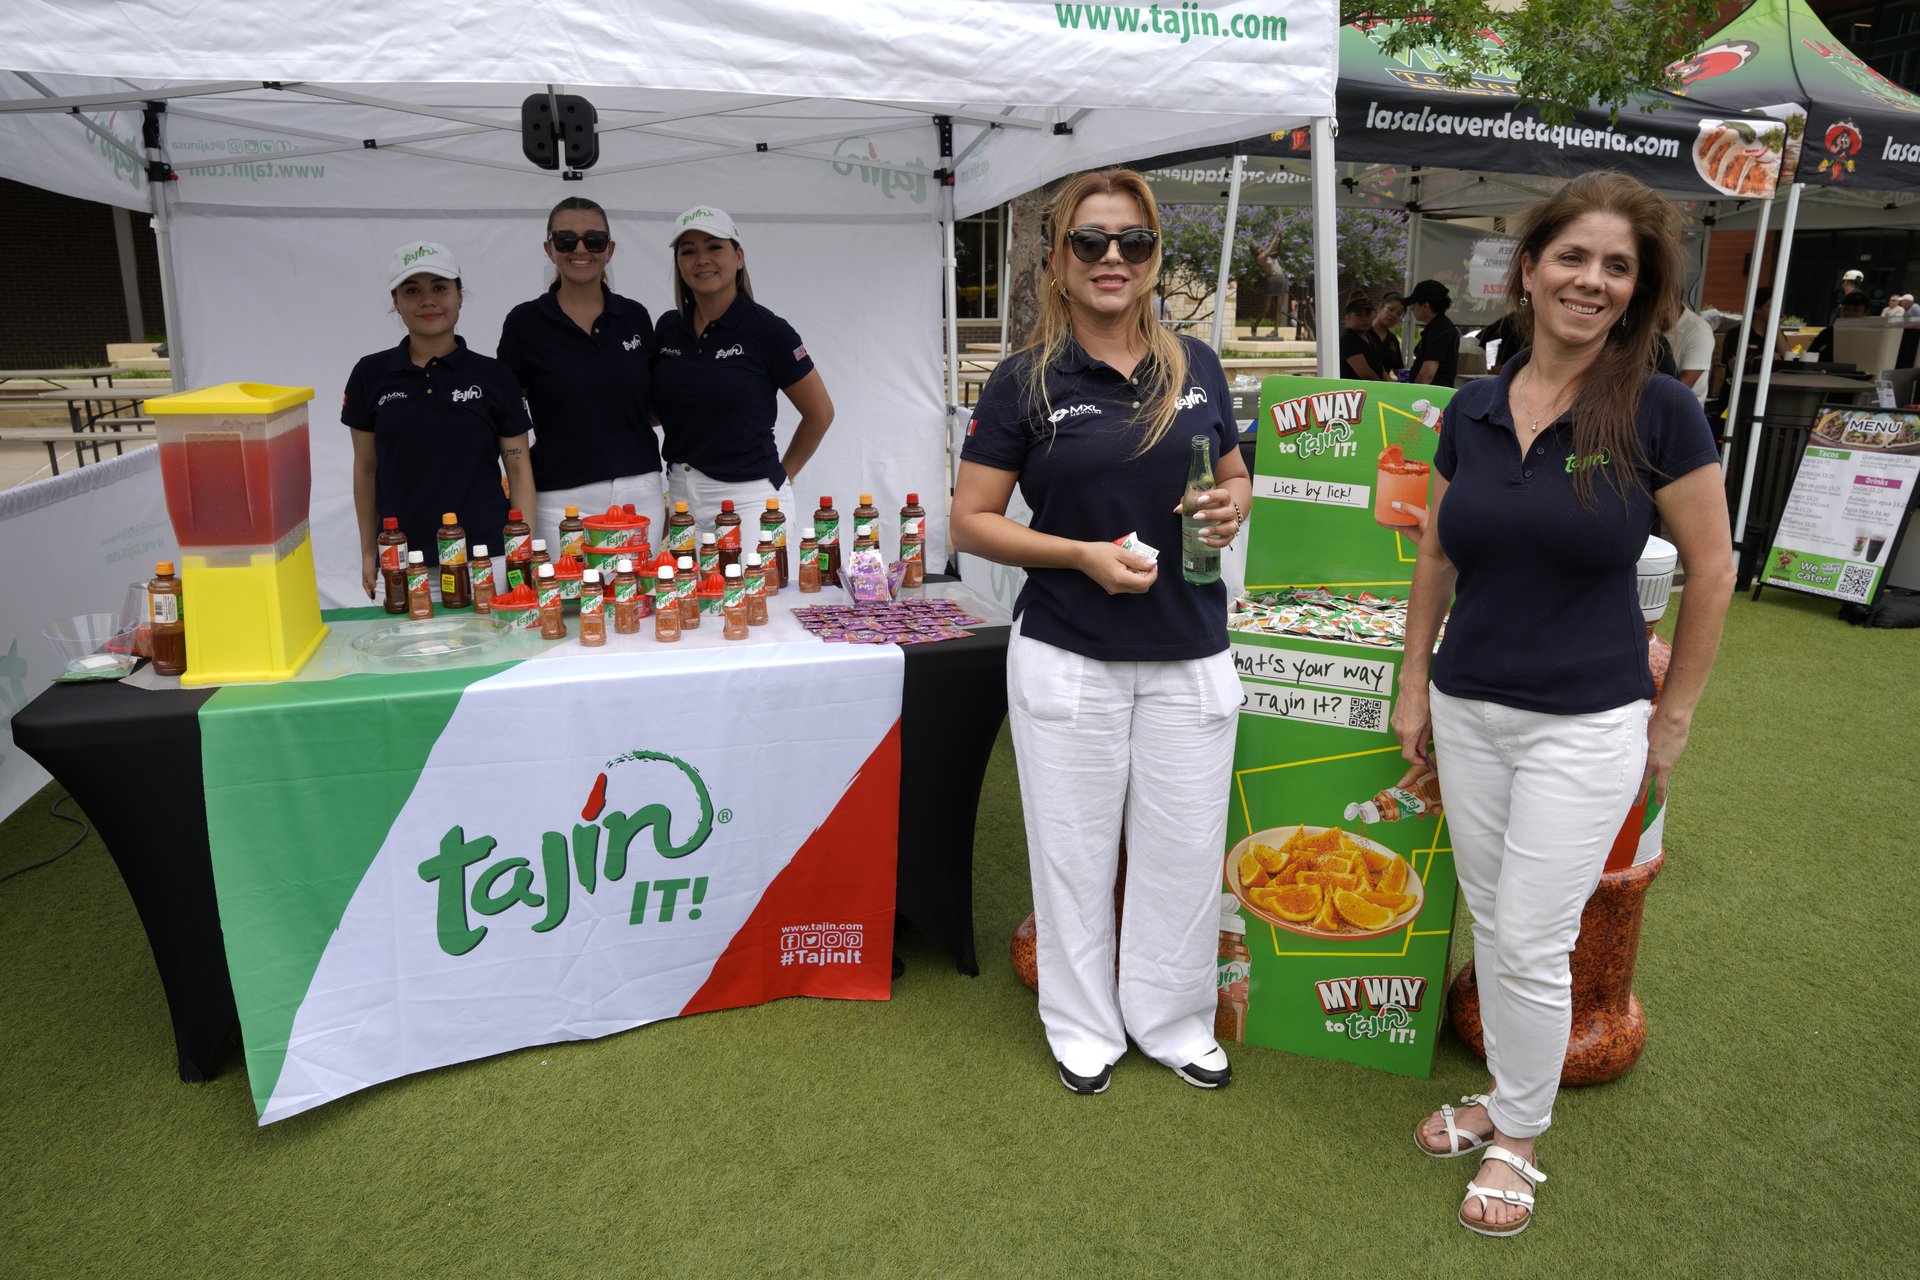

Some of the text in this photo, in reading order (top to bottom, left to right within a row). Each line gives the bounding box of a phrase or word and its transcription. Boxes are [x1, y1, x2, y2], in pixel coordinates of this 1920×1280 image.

[1054, 1, 1288, 43] www.tajin.com
[1366, 101, 1680, 158] lasalsaverdetaqueria.com
[1881, 135, 1920, 163] lasa
[1070, 404, 1102, 414] MXL
[1272, 392, 1364, 433] MY WAY
[1849, 420, 1901, 434] MENU
[1278, 442, 1296, 454] to
[1334, 441, 1357, 458] IT!
[1818, 450, 1840, 459] Tacos
[1865, 477, 1889, 486] Drinks
[1273, 481, 1352, 502] Lick by lick!
[1800, 561, 1819, 573] We
[1796, 571, 1832, 586] cater!
[1231, 651, 1385, 692] hat's your way
[629, 876, 709, 926] IT!
[781, 921, 863, 933] www.tajin.com
[780, 948, 862, 966] #TajinIt
[1317, 978, 1422, 1010] MY WAY
[1325, 1020, 1345, 1033] to
[1389, 1028, 1416, 1044] IT!
